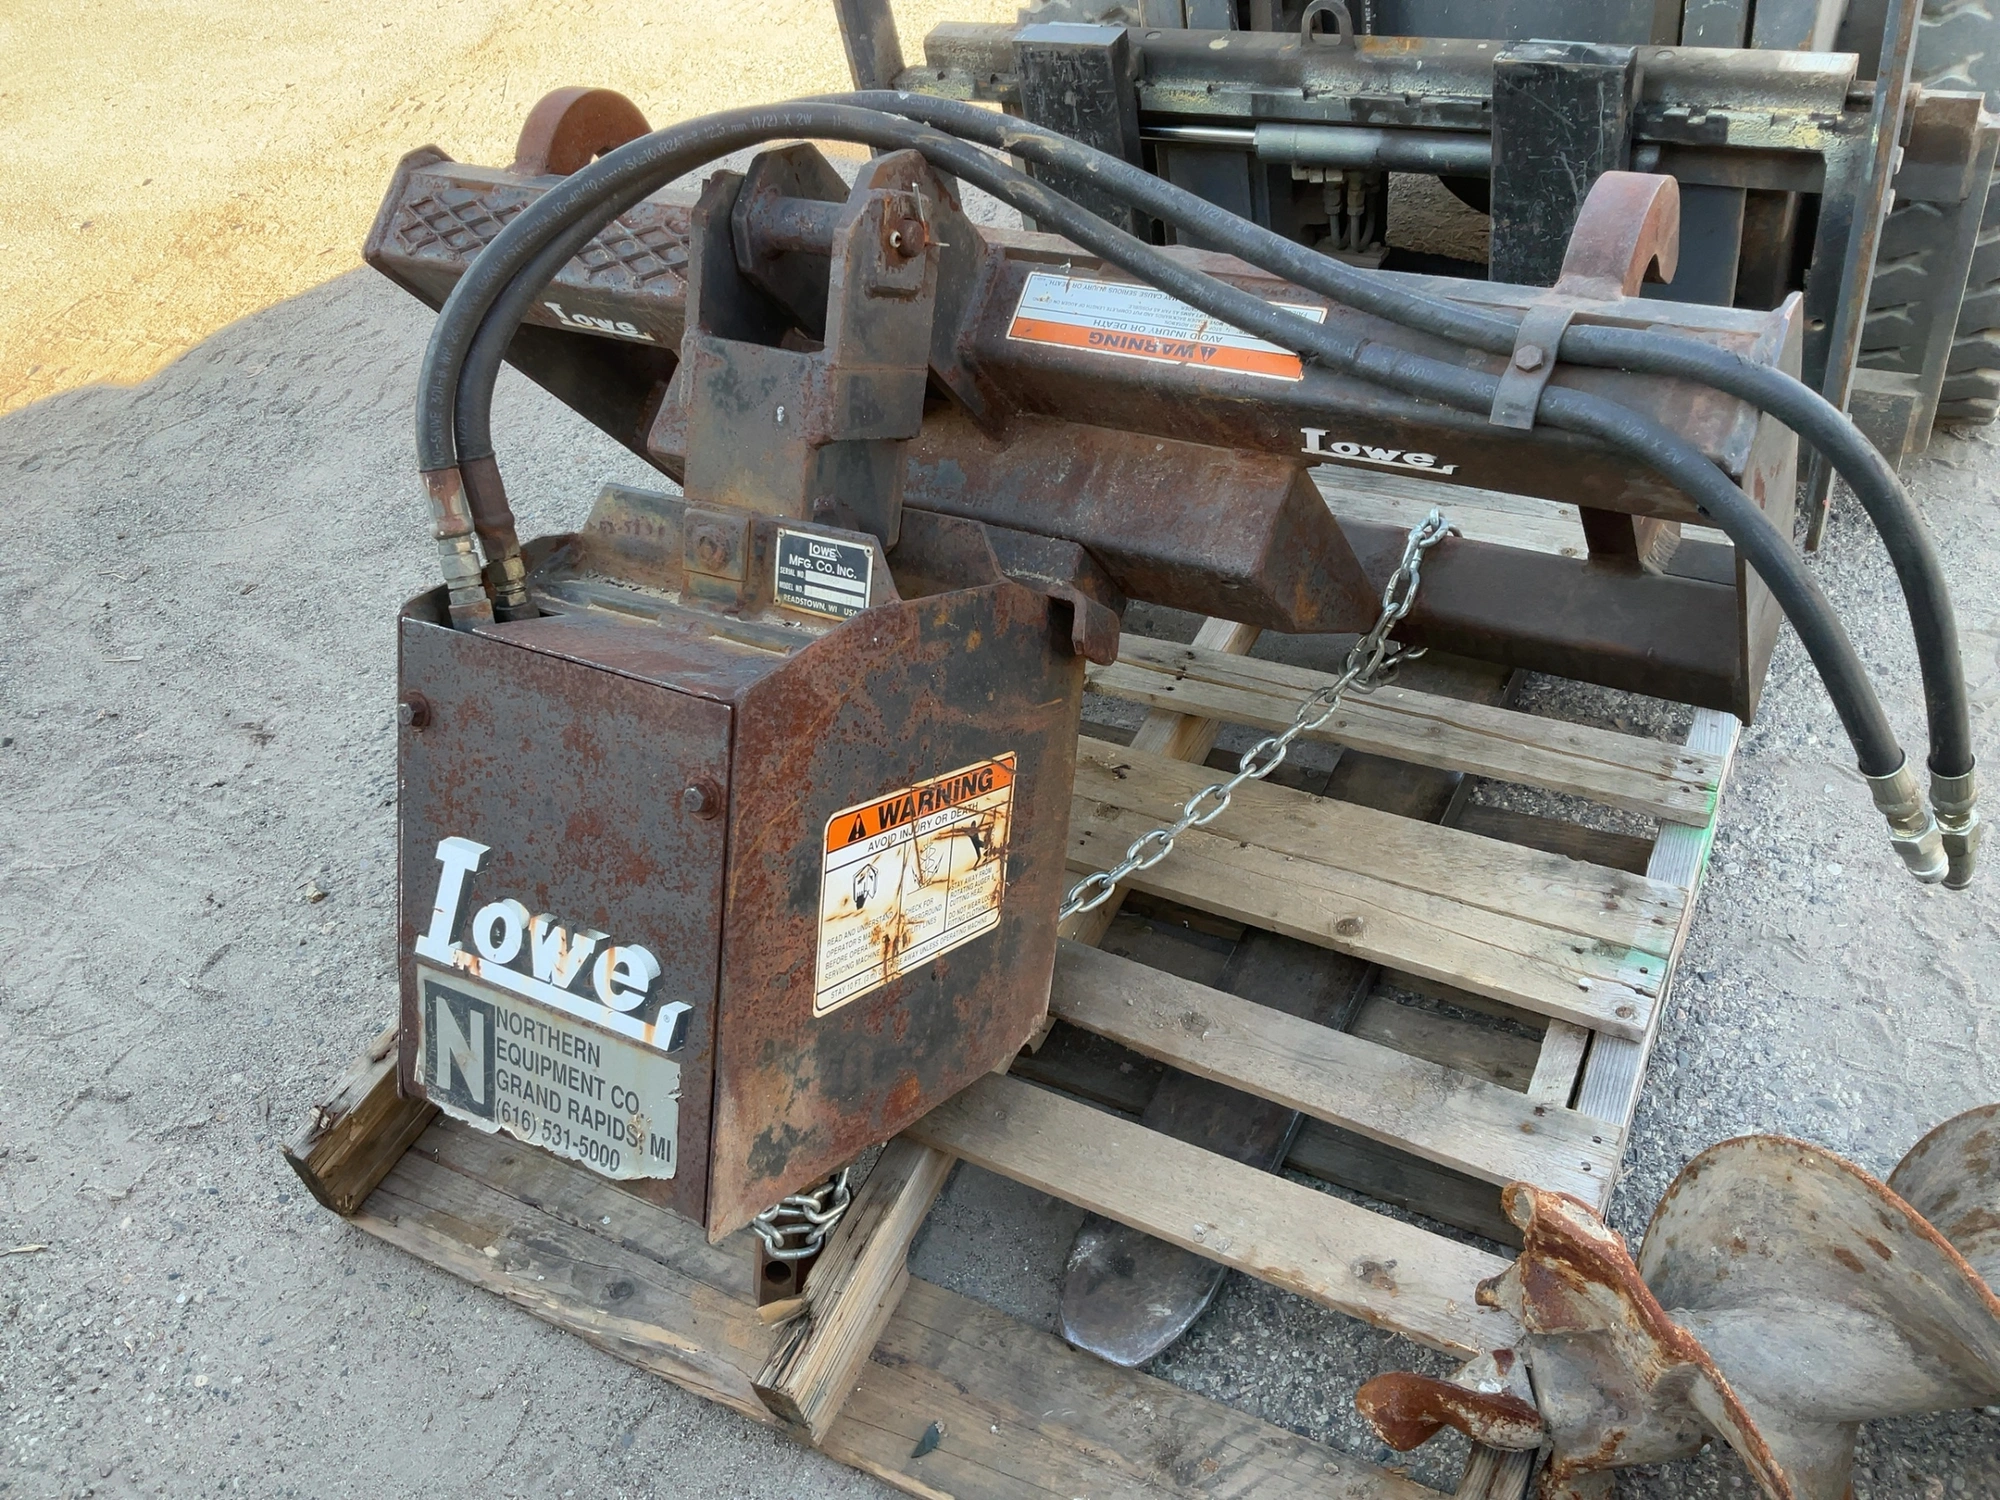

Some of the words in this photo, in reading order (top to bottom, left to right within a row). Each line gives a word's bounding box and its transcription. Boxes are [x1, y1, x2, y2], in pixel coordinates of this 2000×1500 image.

[1108, 287, 1138, 296] SERIOUS
[1138, 291, 1162, 300] CAUSE
[544, 301, 655, 341] Lowe
[1093, 319, 1128, 331] DEATH
[1130, 325, 1146, 333] OR
[1088, 331, 1197, 358] WARNING
[1149, 328, 1188, 340] INJURY
[1190, 332, 1224, 344] AVOID
[1300, 427, 1459, 475] Lowe
[780, 566, 796, 577] SERIAL
[789, 553, 813, 569] MFG.
[816, 560, 835, 574] CO.
[837, 564, 857, 579] INC.
[828, 604, 838, 613] WI
[878, 768, 993, 829] WARNING
[867, 833, 897, 852] AVOID
[900, 820, 932, 839] INJURY
[935, 816, 948, 826] OR
[950, 802, 979, 820] DEATH
[923, 897, 934, 907] FOR
[949, 892, 970, 908] CUTTING
[970, 886, 984, 897] HEAD
[923, 916, 937, 929] LINES
[947, 914, 966, 928] FITTING
[966, 903, 989, 919] CLOTHING
[956, 905, 967, 916] NOT
[415, 836, 693, 1050] Lowe
[826, 935, 843, 947] READ
[844, 930, 856, 939] AND
[824, 960, 855, 981] SERVICING
[855, 949, 881, 965] MACHINE
[825, 951, 849, 970] BEFORE
[830, 986, 846, 999] STAY
[854, 978, 862, 988] FT.
[919, 940, 939, 954] UNLESS
[940, 927, 967, 945] OPERATING
[967, 916, 988, 930] MACHINE
[496, 1004, 601, 1067] NORTHERN
[435, 995, 484, 1104] N
[497, 1039, 605, 1099] EQUIPMENT
[611, 1085, 645, 1119] CO.
[496, 1069, 561, 1114] GRAND
[568, 1099, 644, 1156] RAPIDS,
[650, 1133, 671, 1162] MI
[496, 1098, 537, 1133] (616)
[541, 1119, 620, 1173] 531-5000
